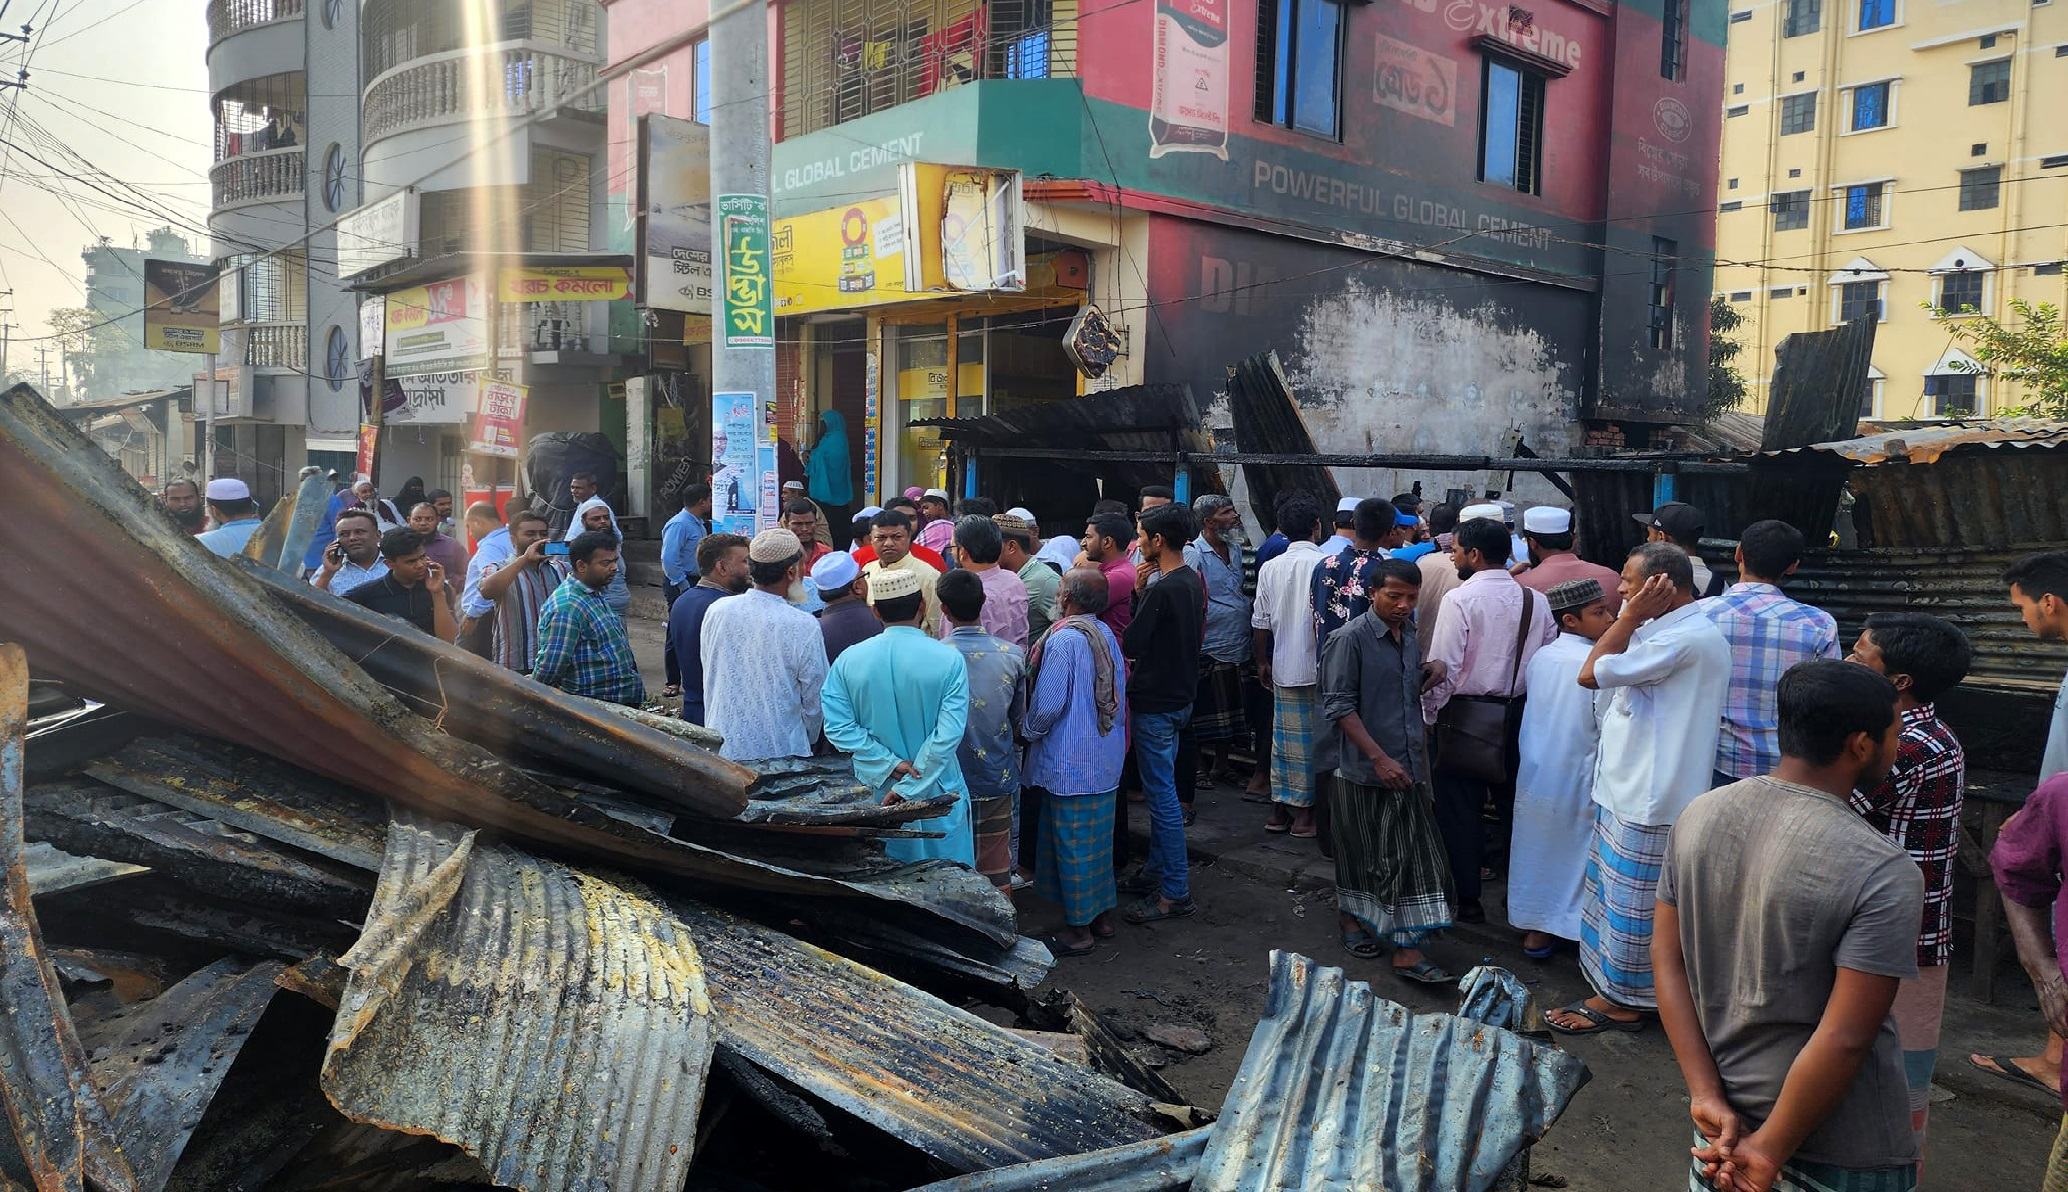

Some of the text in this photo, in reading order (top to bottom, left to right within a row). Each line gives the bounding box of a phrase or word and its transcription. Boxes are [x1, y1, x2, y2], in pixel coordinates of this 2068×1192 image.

[785, 157, 845, 191] GLOBAL
[849, 132, 924, 173] CEMENT
[1254, 160, 1552, 251] POWERFUL GLOBAL CEMENT
[554, 277, 613, 294] কমলো
